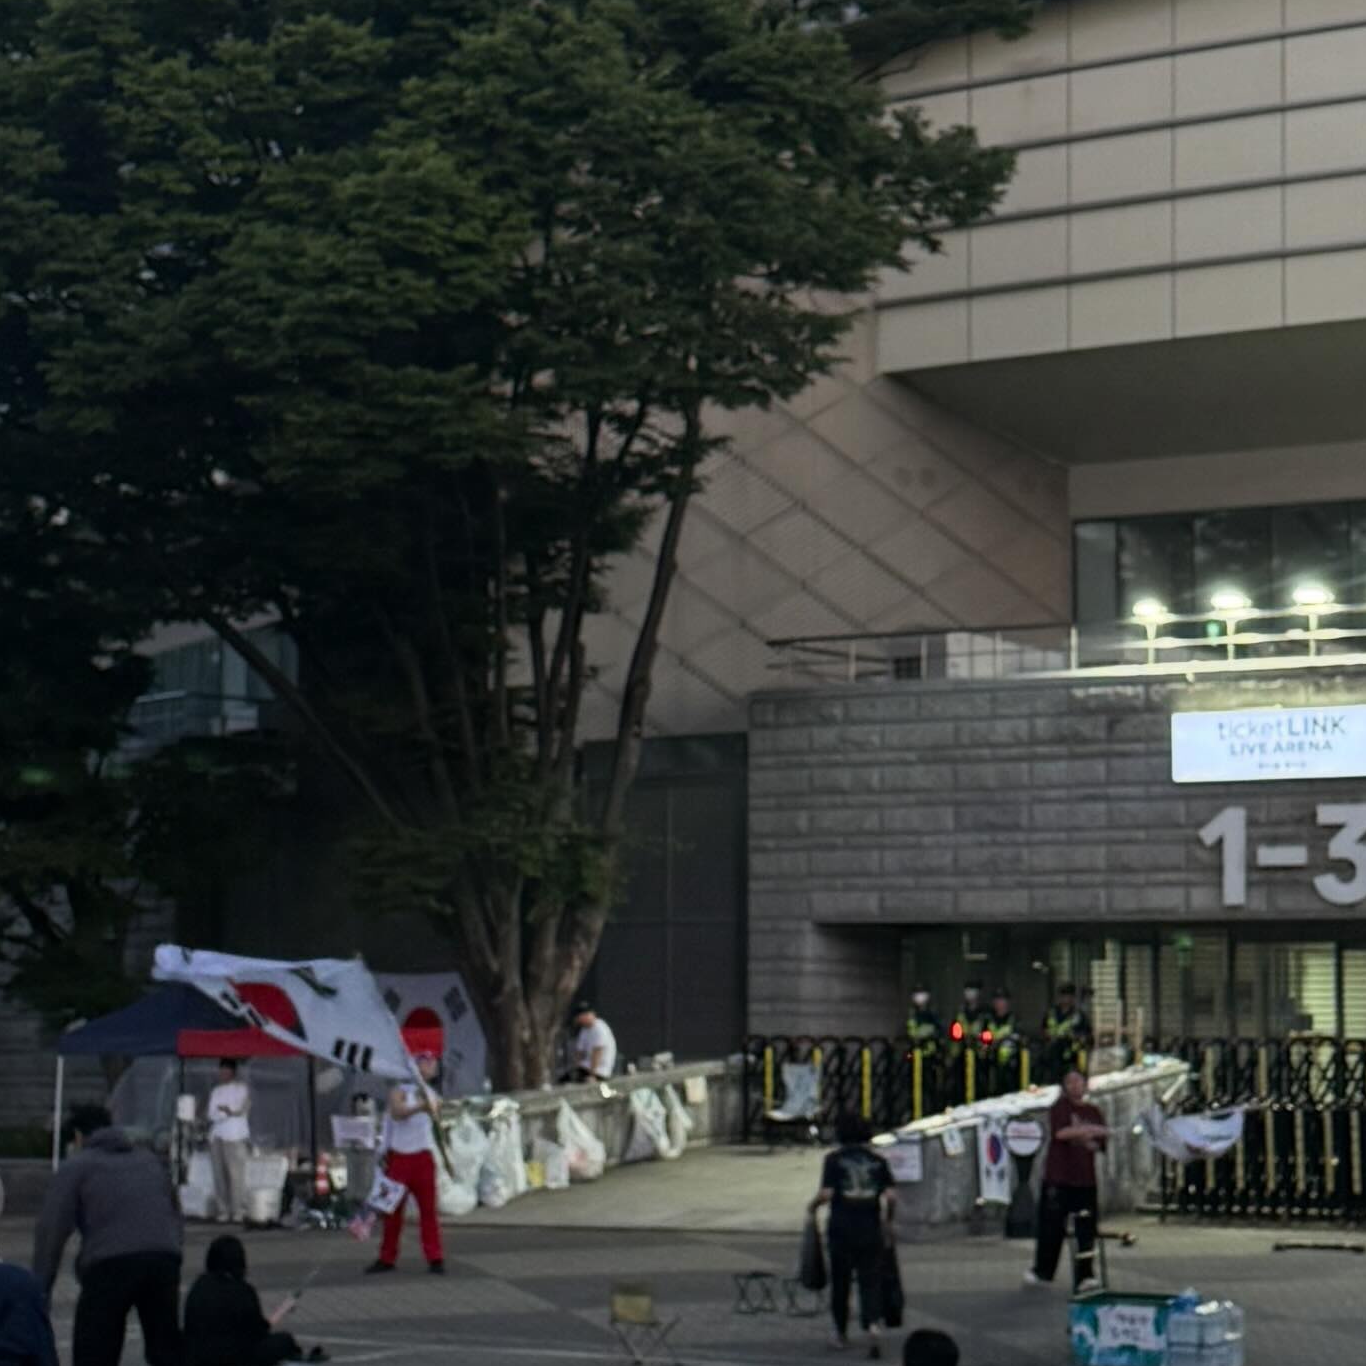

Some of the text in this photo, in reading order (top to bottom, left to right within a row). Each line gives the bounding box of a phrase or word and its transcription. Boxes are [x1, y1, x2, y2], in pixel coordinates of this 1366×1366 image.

[1218, 715, 1346, 740] ticketLINK
[1229, 738, 1334, 757] LIVE ARENA
